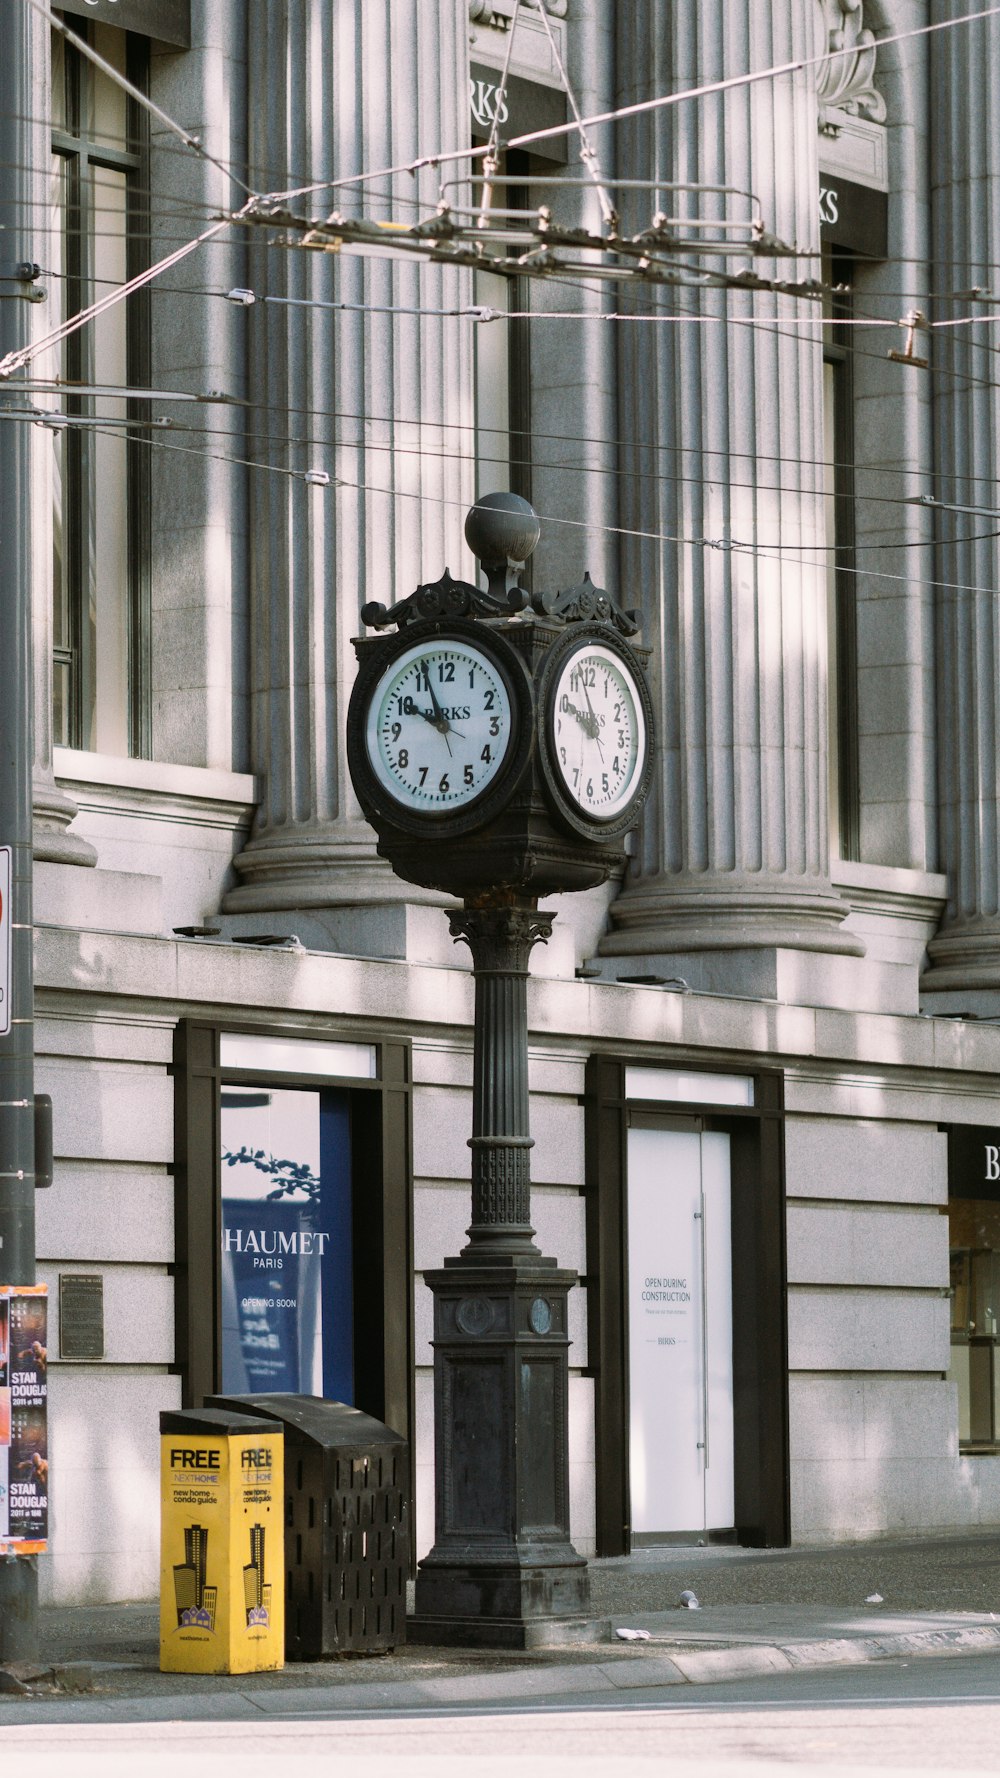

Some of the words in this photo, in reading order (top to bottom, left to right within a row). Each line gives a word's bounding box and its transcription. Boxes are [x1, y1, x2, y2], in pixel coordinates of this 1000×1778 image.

[438, 662, 455, 682] 12
[468, 669, 474, 689] 1
[584, 667, 595, 687] 12
[604, 679, 608, 698] 1
[398, 696, 413, 715] 10
[483, 690, 494, 710] 2
[613, 703, 621, 722] 2
[391, 722, 402, 742] 9
[489, 716, 499, 736] 3
[617, 730, 625, 748] 3
[398, 749, 409, 768] 8
[480, 744, 491, 764] 4
[463, 765, 473, 784] 5
[612, 756, 620, 775] 4
[418, 767, 429, 787] 7
[439, 773, 449, 793] 6
[573, 768, 579, 787] 7
[602, 773, 608, 792] 5
[586, 778, 593, 797] 6
[984, 1145, 1000, 1180] B
[253, 1258, 283, 1269] PARIS
[644, 1278, 661, 1288] OPEN
[663, 1278, 687, 1289] DURING
[242, 1298, 275, 1308] OPENING
[276, 1299, 297, 1308] SOON
[641, 1291, 691, 1302] CONSTRUCTION
[658, 1337, 676, 1345] BIRKS
[11, 1371, 37, 1384] STAN
[170, 1449, 220, 1469] FREE
[241, 1448, 272, 1468] FREE
[174, 1474, 218, 1483] NEXTHOME
[10, 1483, 36, 1495] STAN
[190, 1489, 211, 1497] home
[10, 1495, 48, 1508] DOUGLAS
[197, 1496, 217, 1505] guide
